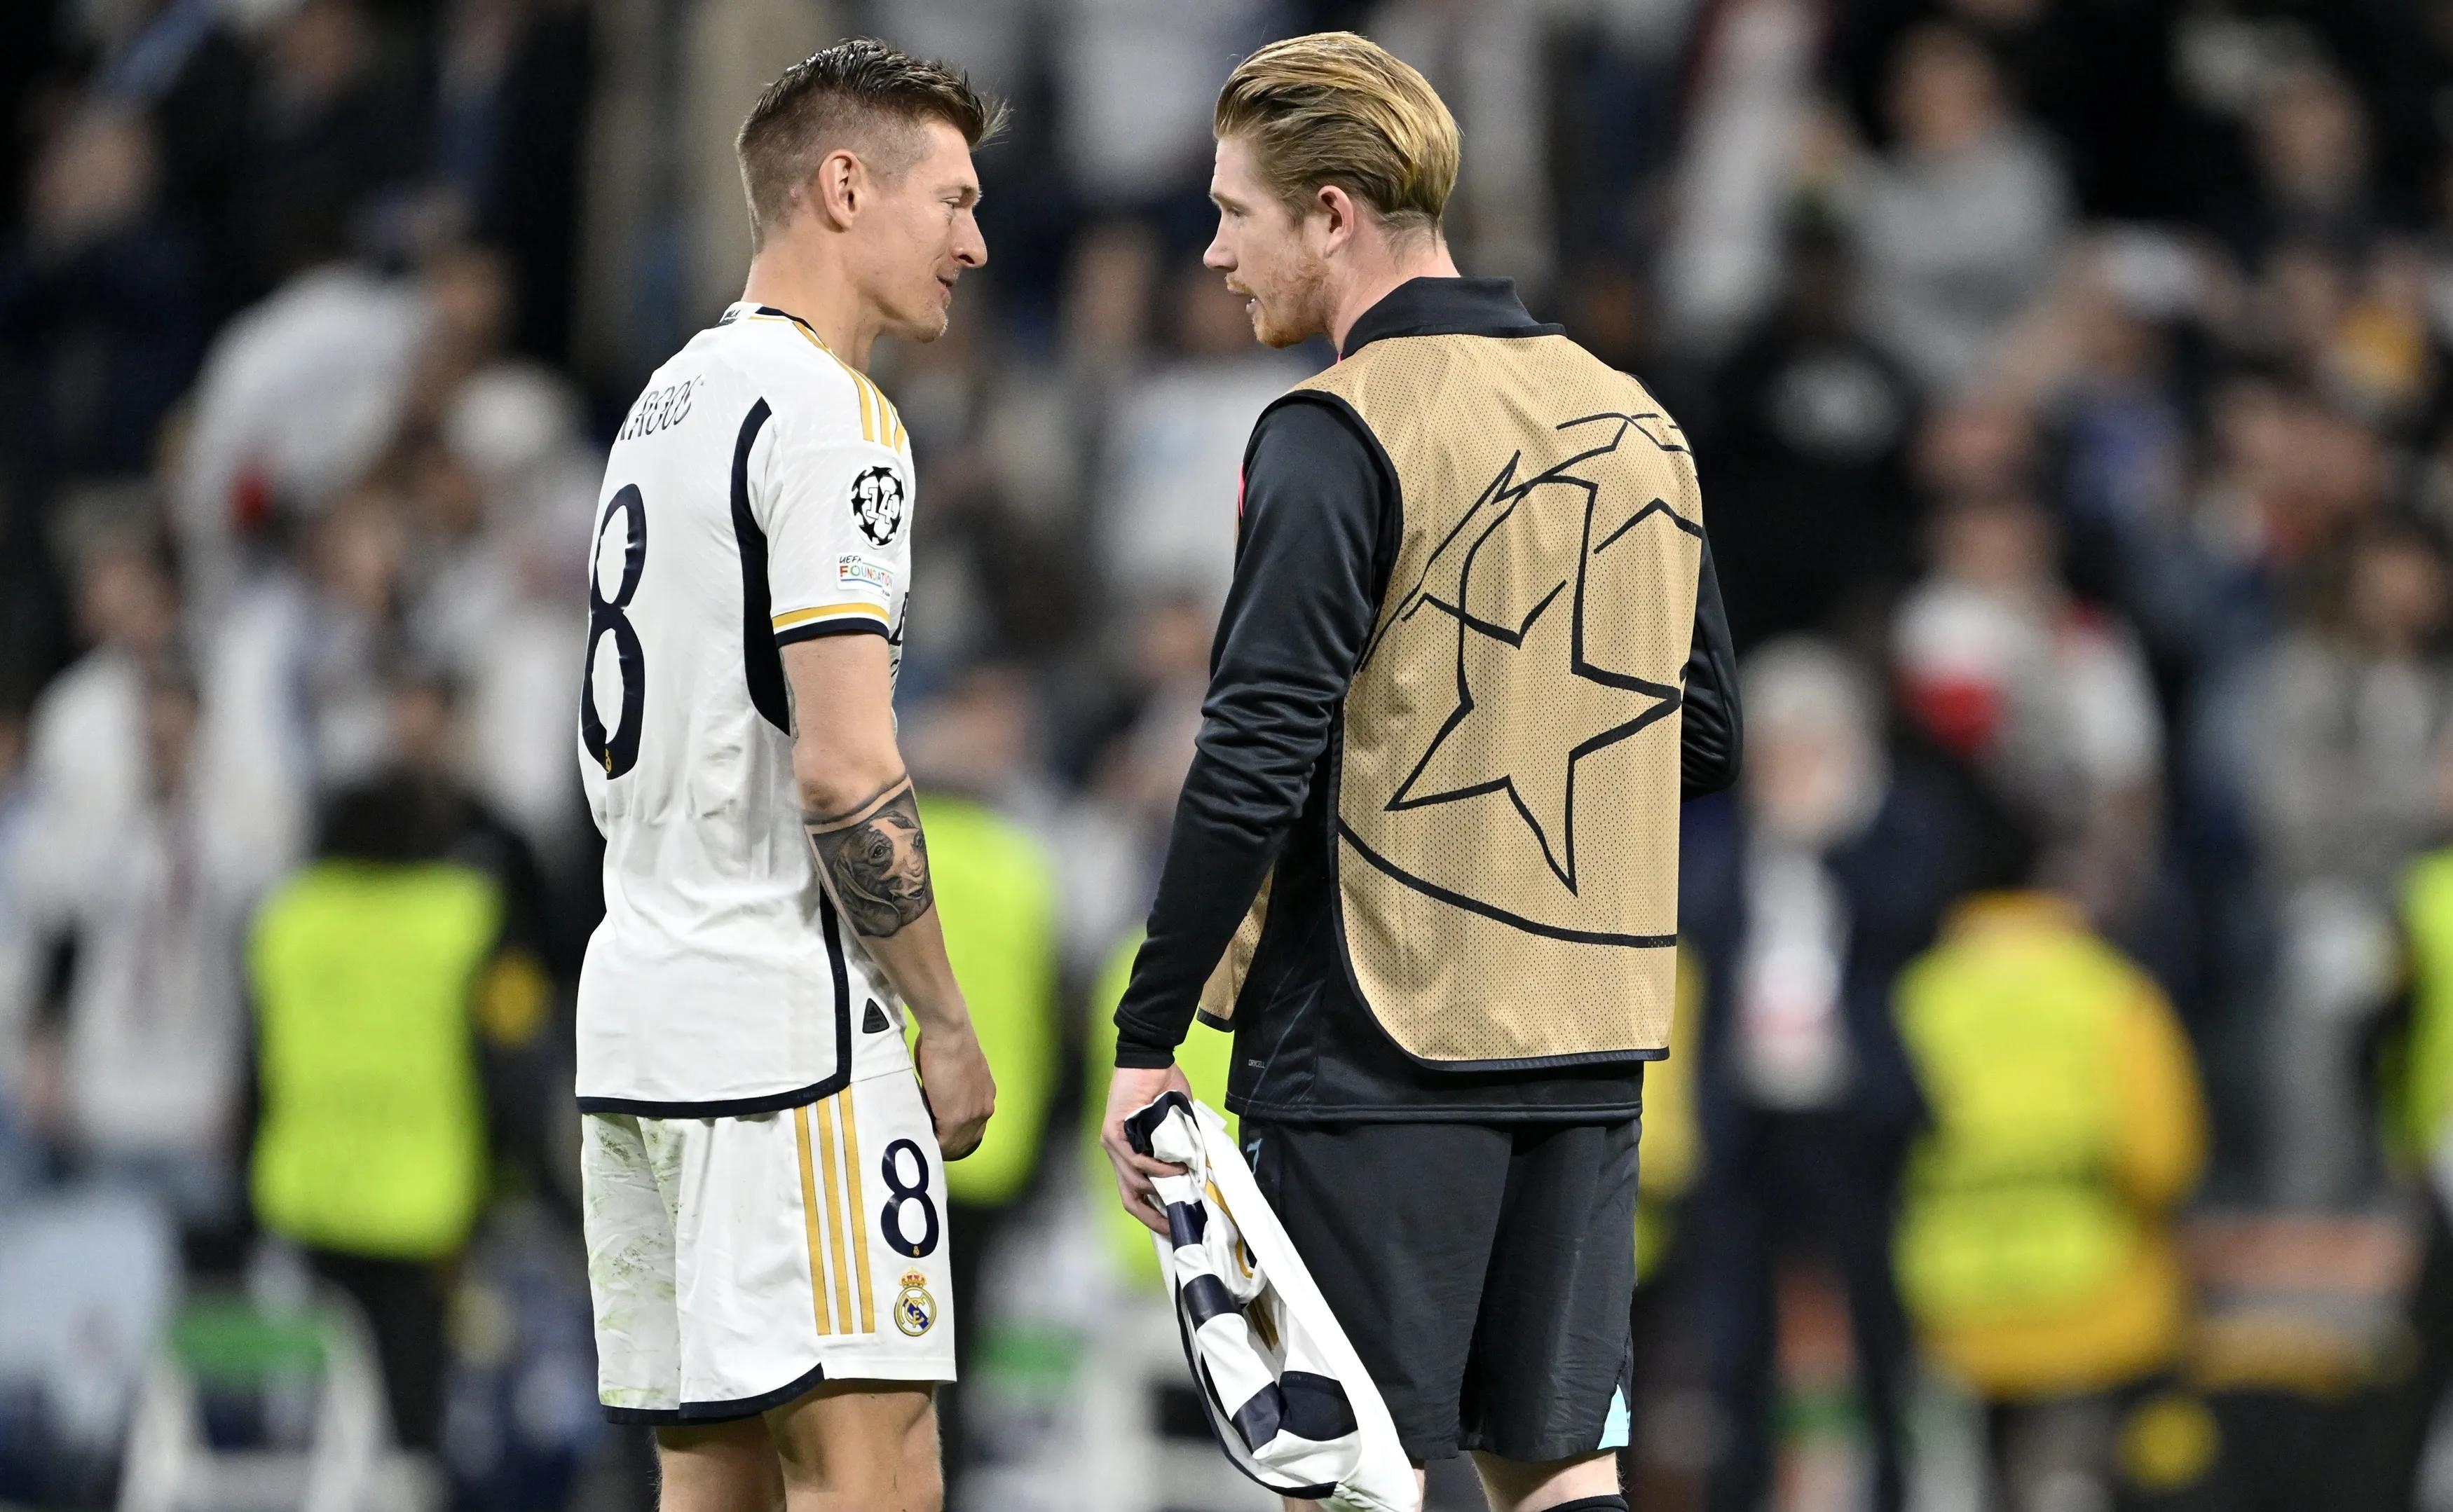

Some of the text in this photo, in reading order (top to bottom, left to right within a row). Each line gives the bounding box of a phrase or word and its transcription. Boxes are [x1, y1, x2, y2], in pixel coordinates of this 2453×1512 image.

[866, 487, 894, 524] 14
[839, 555, 862, 563] UEFA
[581, 483, 647, 780] 8
[880, 1139, 939, 1258] 8
